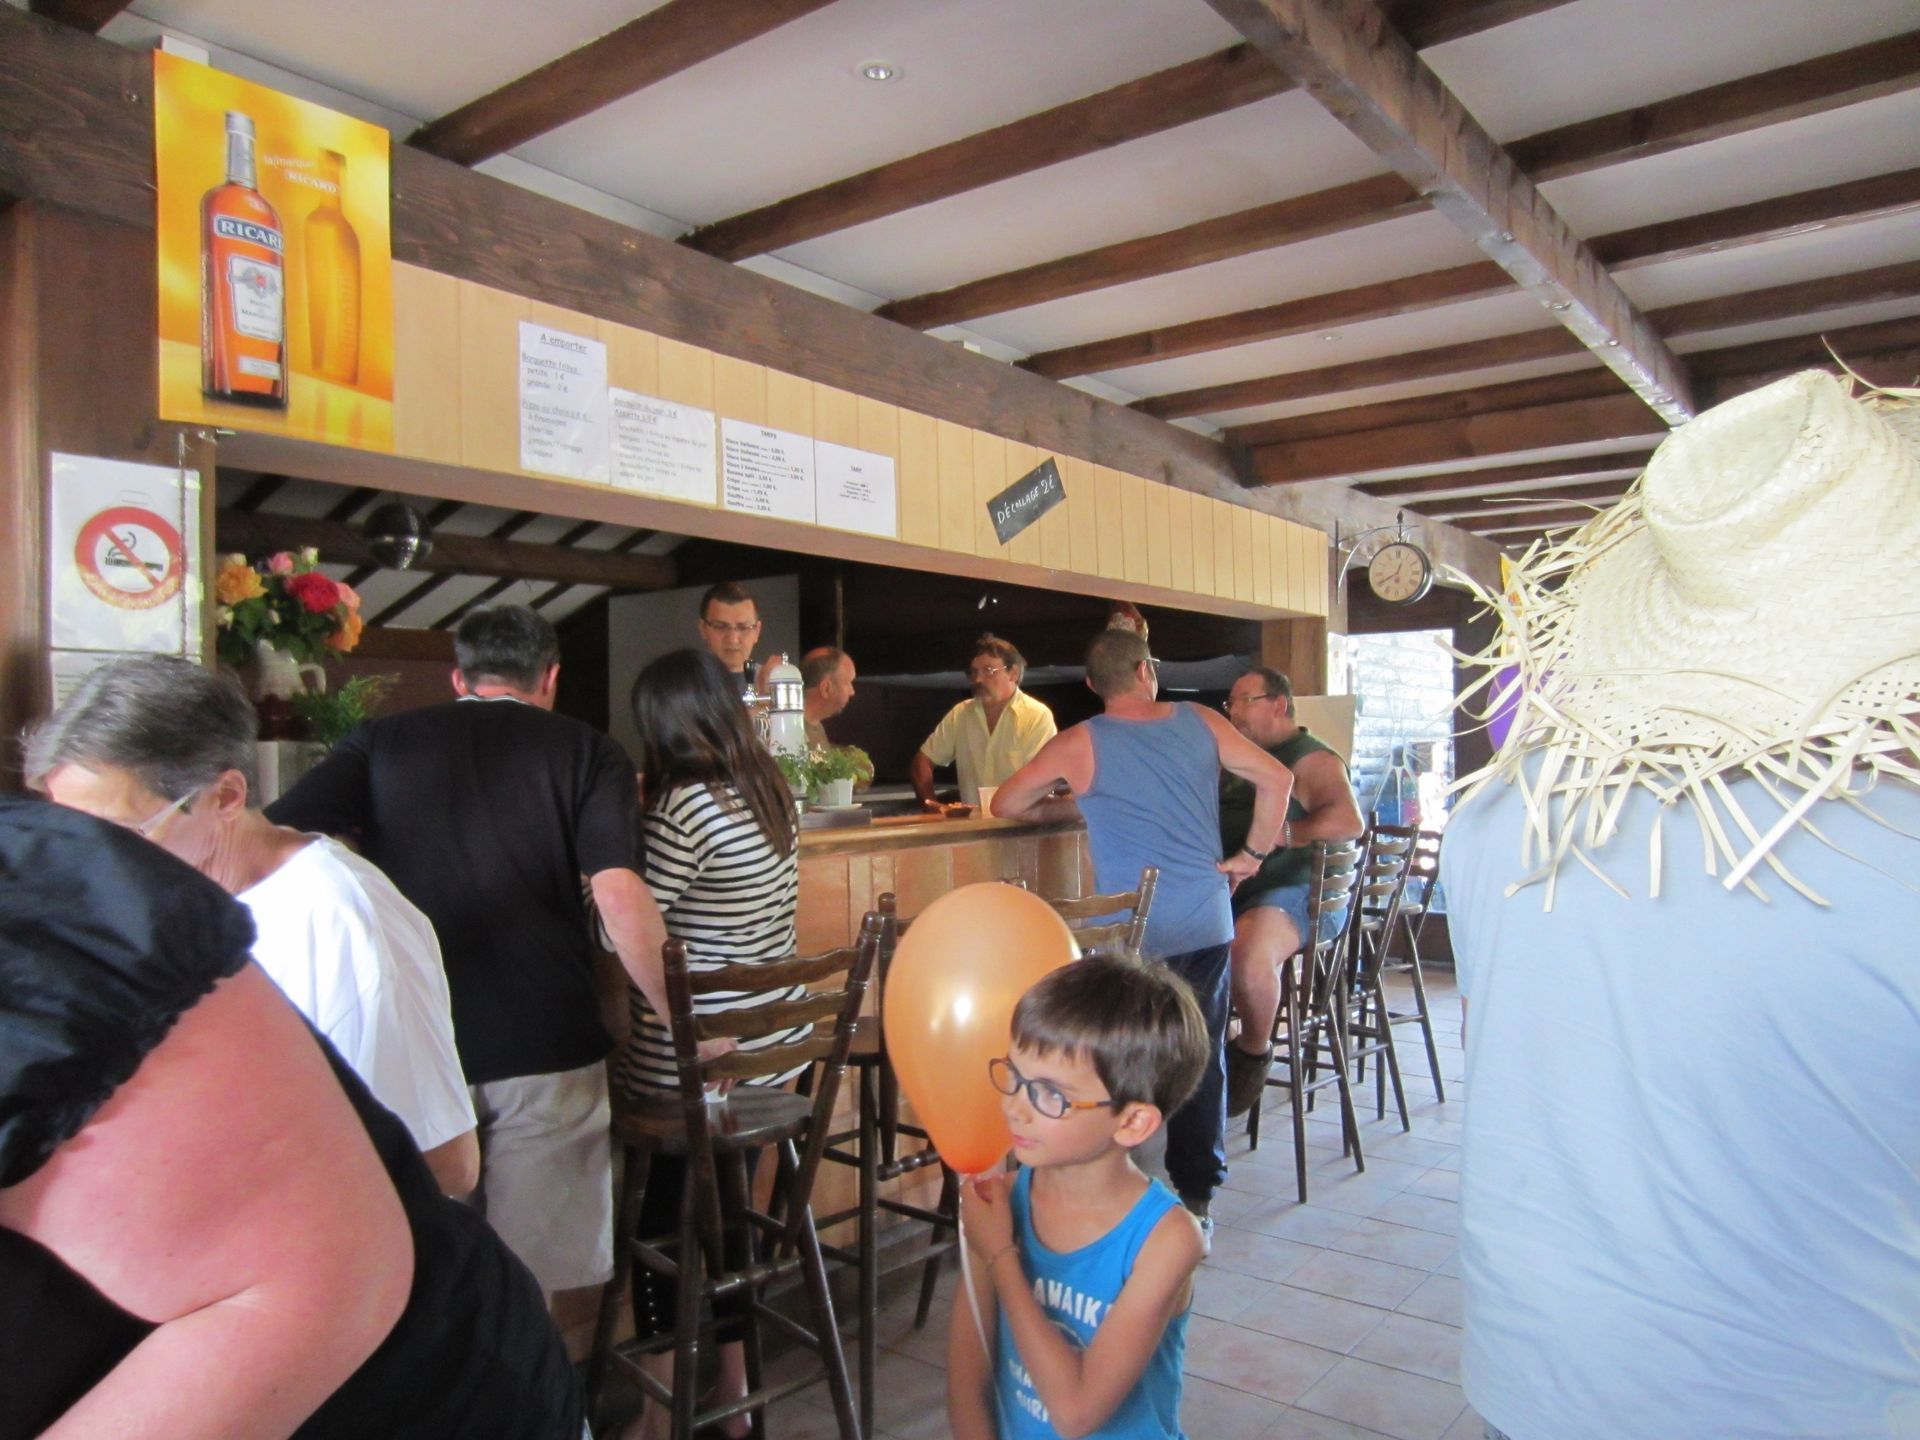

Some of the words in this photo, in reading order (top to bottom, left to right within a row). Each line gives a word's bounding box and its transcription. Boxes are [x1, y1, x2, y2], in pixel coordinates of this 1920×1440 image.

[287, 172, 337, 193] RICARD
[550, 337, 588, 352] emporter
[997, 483, 1040, 525] DÉCOLLAGE
[1034, 1278, 1112, 1328] AWAIK
